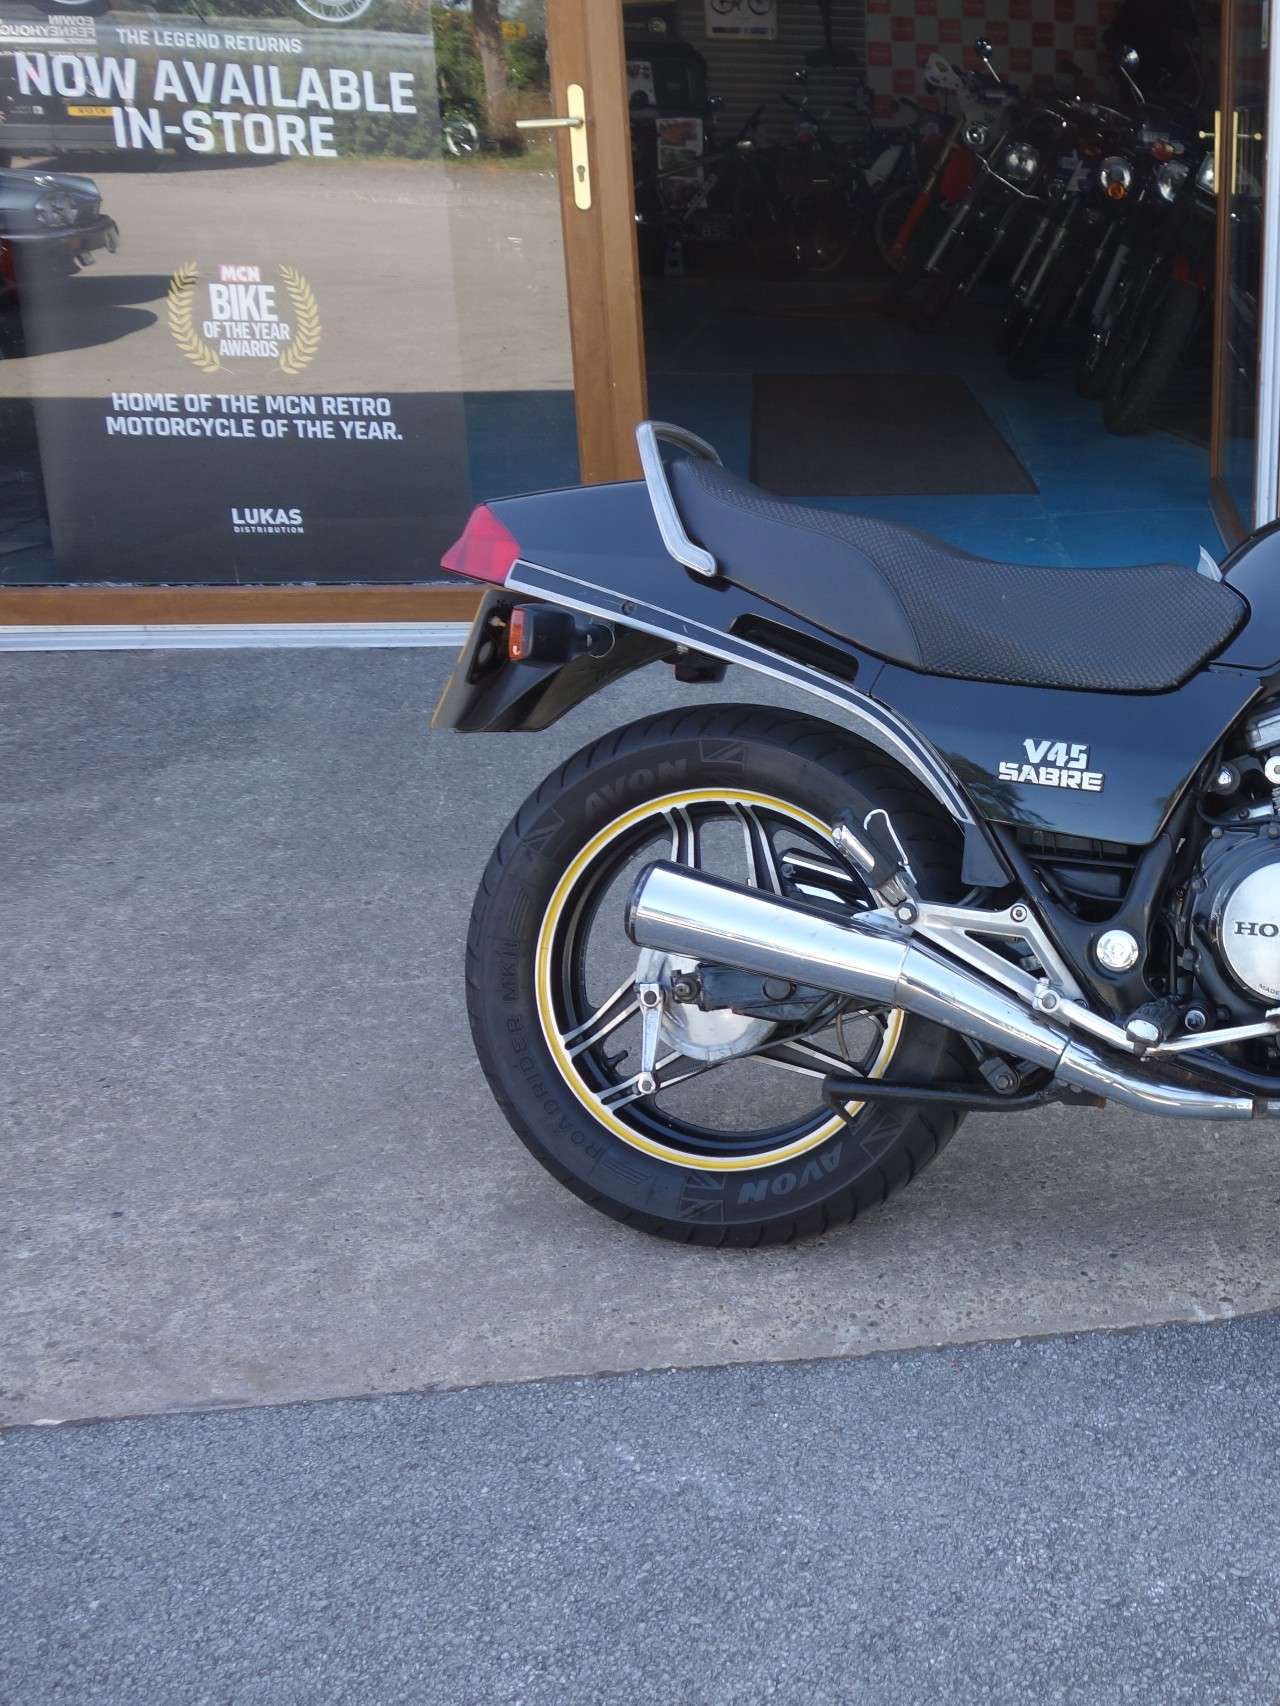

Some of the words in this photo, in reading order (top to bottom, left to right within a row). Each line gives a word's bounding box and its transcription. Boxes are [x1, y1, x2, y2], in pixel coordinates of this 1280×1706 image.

[115, 28, 149, 46] THE
[153, 30, 219, 49] LEGEND
[224, 34, 302, 53] RETURNS
[14, 52, 136, 100] NOW
[153, 59, 417, 114] AVAILABLE
[111, 106, 338, 157] IN-STORE
[219, 264, 260, 281] MCN
[208, 284, 278, 321] BIKE
[203, 321, 222, 339] OF
[223, 321, 248, 339] THE
[250, 322, 290, 340] YEAR
[219, 340, 279, 358] AWARDS
[112, 392, 178, 413] HOME
[184, 394, 212, 413] OF
[218, 394, 259, 414] THE
[266, 395, 315, 415] MCN
[322, 397, 391, 416] RETRO
[106, 416, 256, 438] MOTORCYCLE
[262, 419, 288, 438] OF
[293, 419, 335, 439] THE
[340, 420, 403, 440] YEAR.
[231, 507, 303, 525] LUKAS
[1023, 738, 1090, 769] V45
[583, 757, 689, 815] AVON
[998, 761, 1104, 792] SABRE
[1258, 983, 1280, 996] MADE
[737, 1145, 844, 1206] AVON
